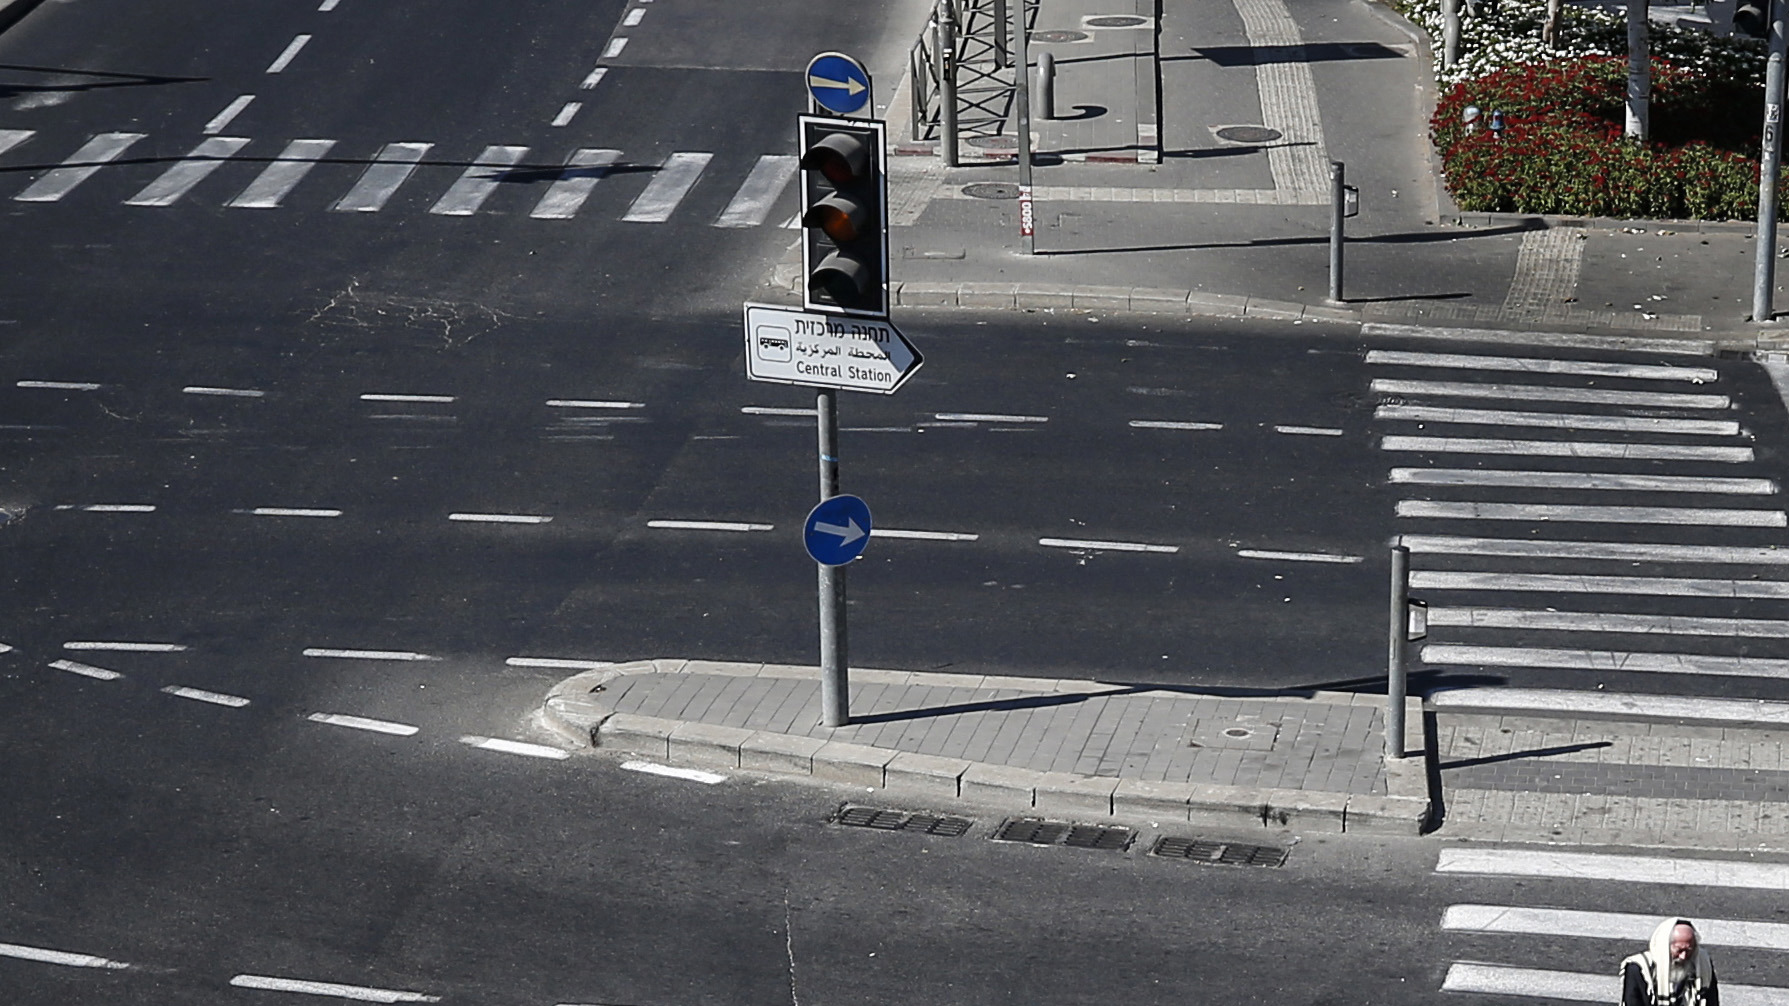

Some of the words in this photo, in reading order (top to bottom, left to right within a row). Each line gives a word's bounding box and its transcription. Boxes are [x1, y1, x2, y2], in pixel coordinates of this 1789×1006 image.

[795, 320, 845, 338] מרכזית
[851, 325, 890, 343] תחנה
[796, 341, 842, 358] المركزية
[848, 347, 891, 360] المحطة
[797, 361, 842, 377] Central
[848, 366, 892, 382] Station
